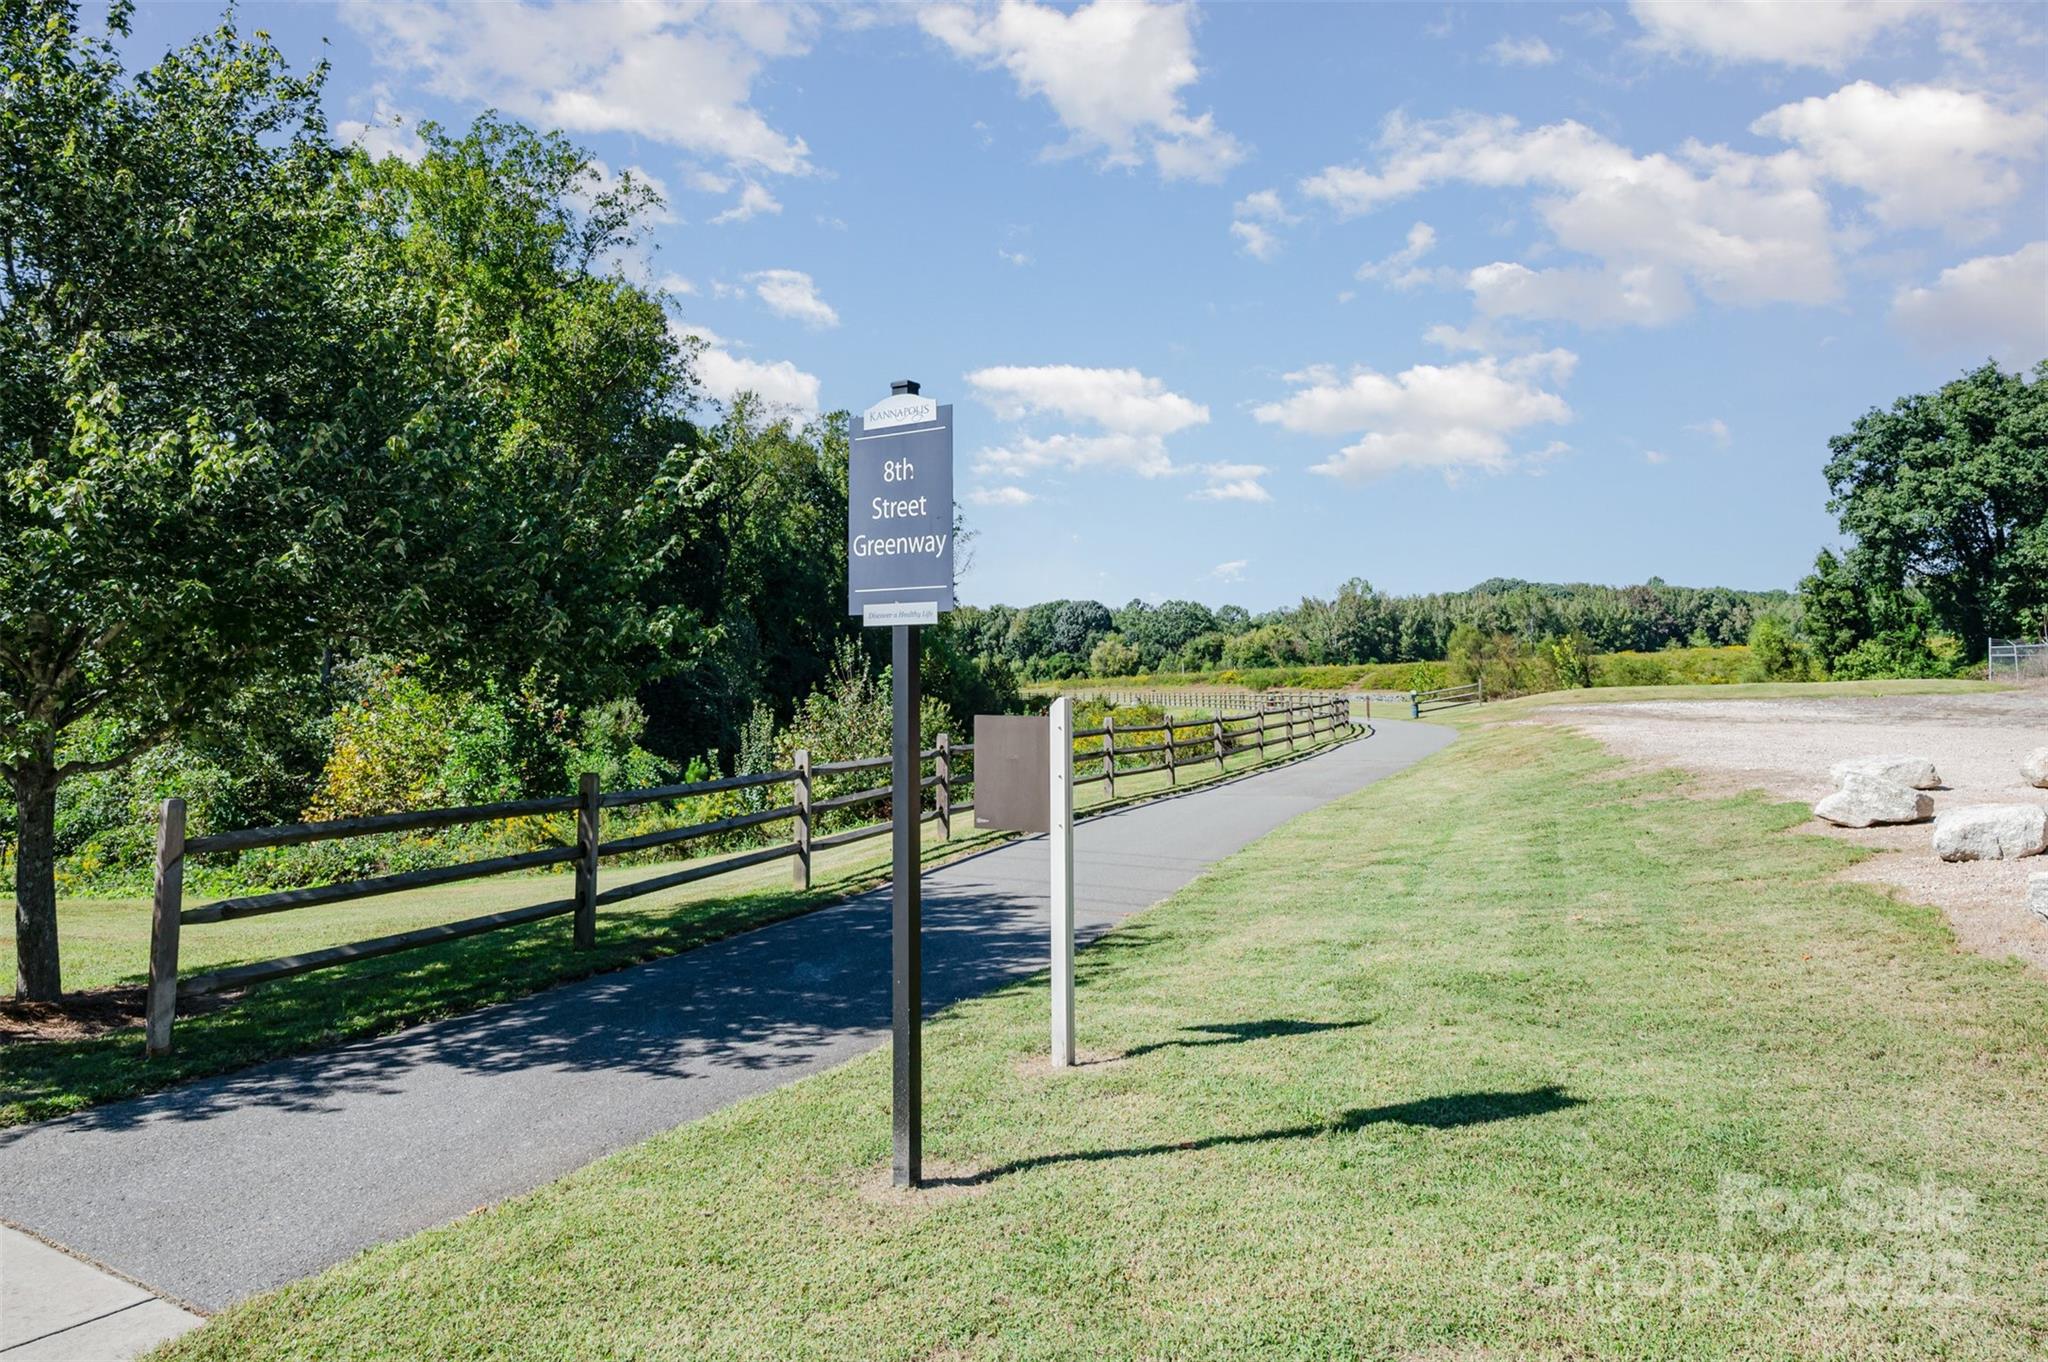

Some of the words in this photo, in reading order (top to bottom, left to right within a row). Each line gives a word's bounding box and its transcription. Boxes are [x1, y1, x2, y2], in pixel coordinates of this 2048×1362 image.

[869, 403, 931, 422] KANNAPOLIS
[883, 457, 914, 482] 8th
[871, 496, 927, 519] Street
[853, 534, 947, 558] Greenway
[899, 608, 922, 620] Healthy
[922, 607, 933, 618] Life
